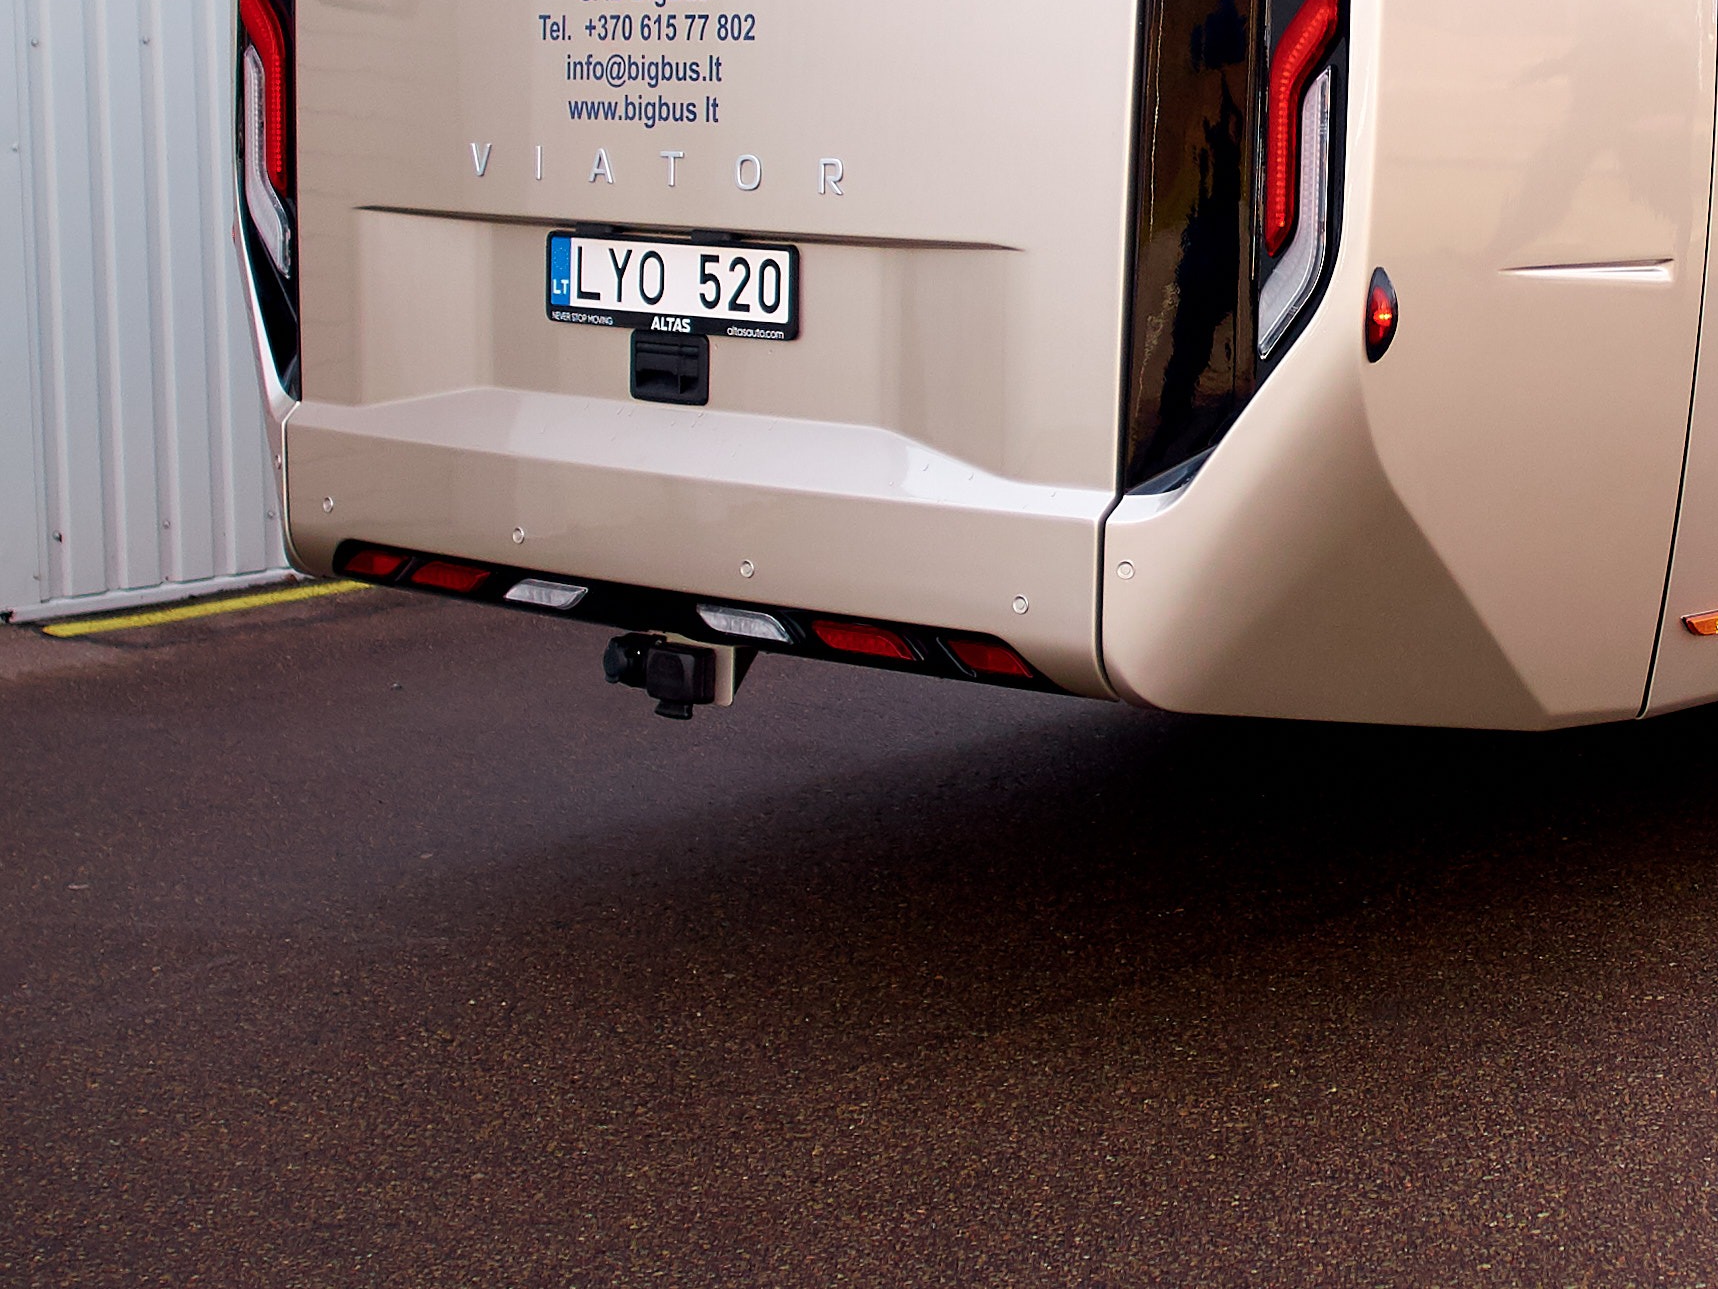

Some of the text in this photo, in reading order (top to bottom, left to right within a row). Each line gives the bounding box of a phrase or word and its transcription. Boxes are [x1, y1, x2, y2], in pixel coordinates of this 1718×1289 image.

[539, 14, 756, 41] Tel. +370 615 77 802
[566, 54, 722, 88] info@bigbus.lt
[470, 142, 845, 196] VIATOR
[553, 279, 569, 295] LT
[577, 246, 781, 314] LYO 520
[651, 316, 691, 332] ALTAS
